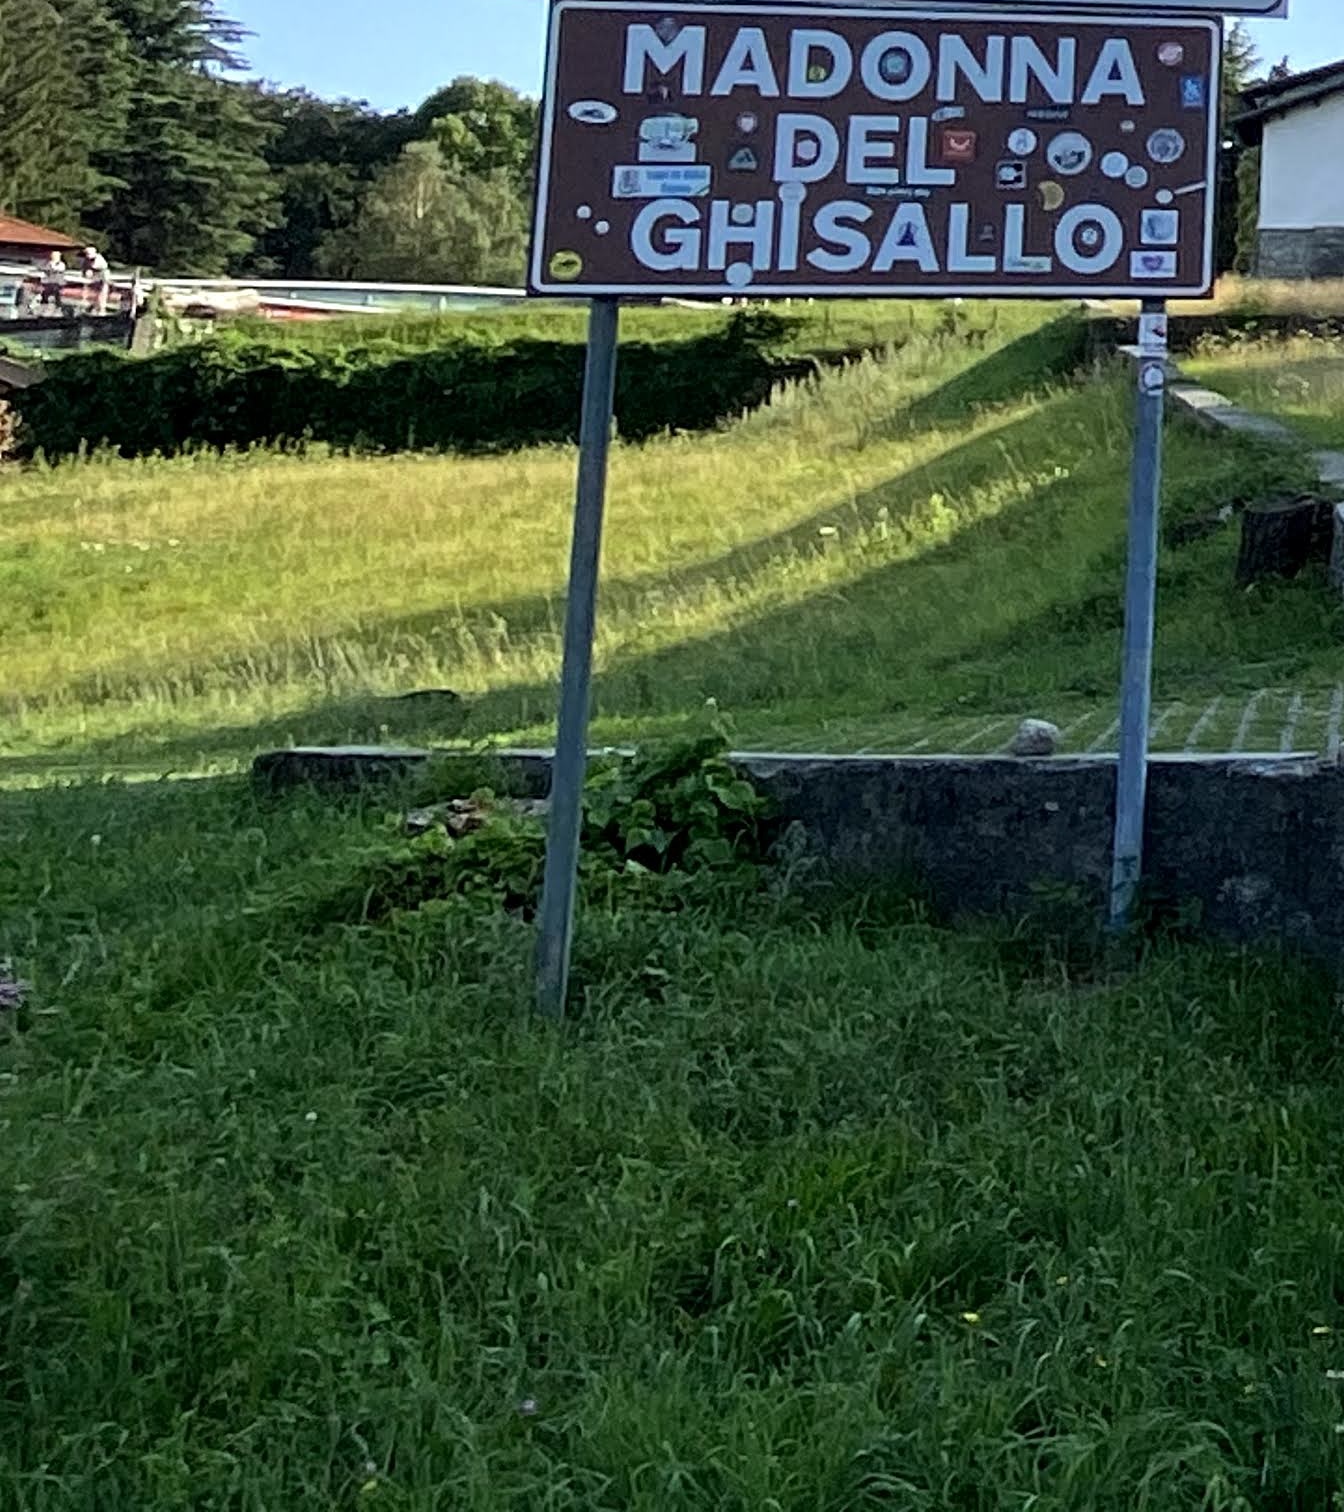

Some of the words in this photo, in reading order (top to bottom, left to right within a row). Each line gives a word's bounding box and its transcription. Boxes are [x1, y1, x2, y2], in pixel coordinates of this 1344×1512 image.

[623, 23, 1145, 105] MADONNA
[773, 113, 956, 185] DEL
[631, 198, 1123, 274] GHISALLO
